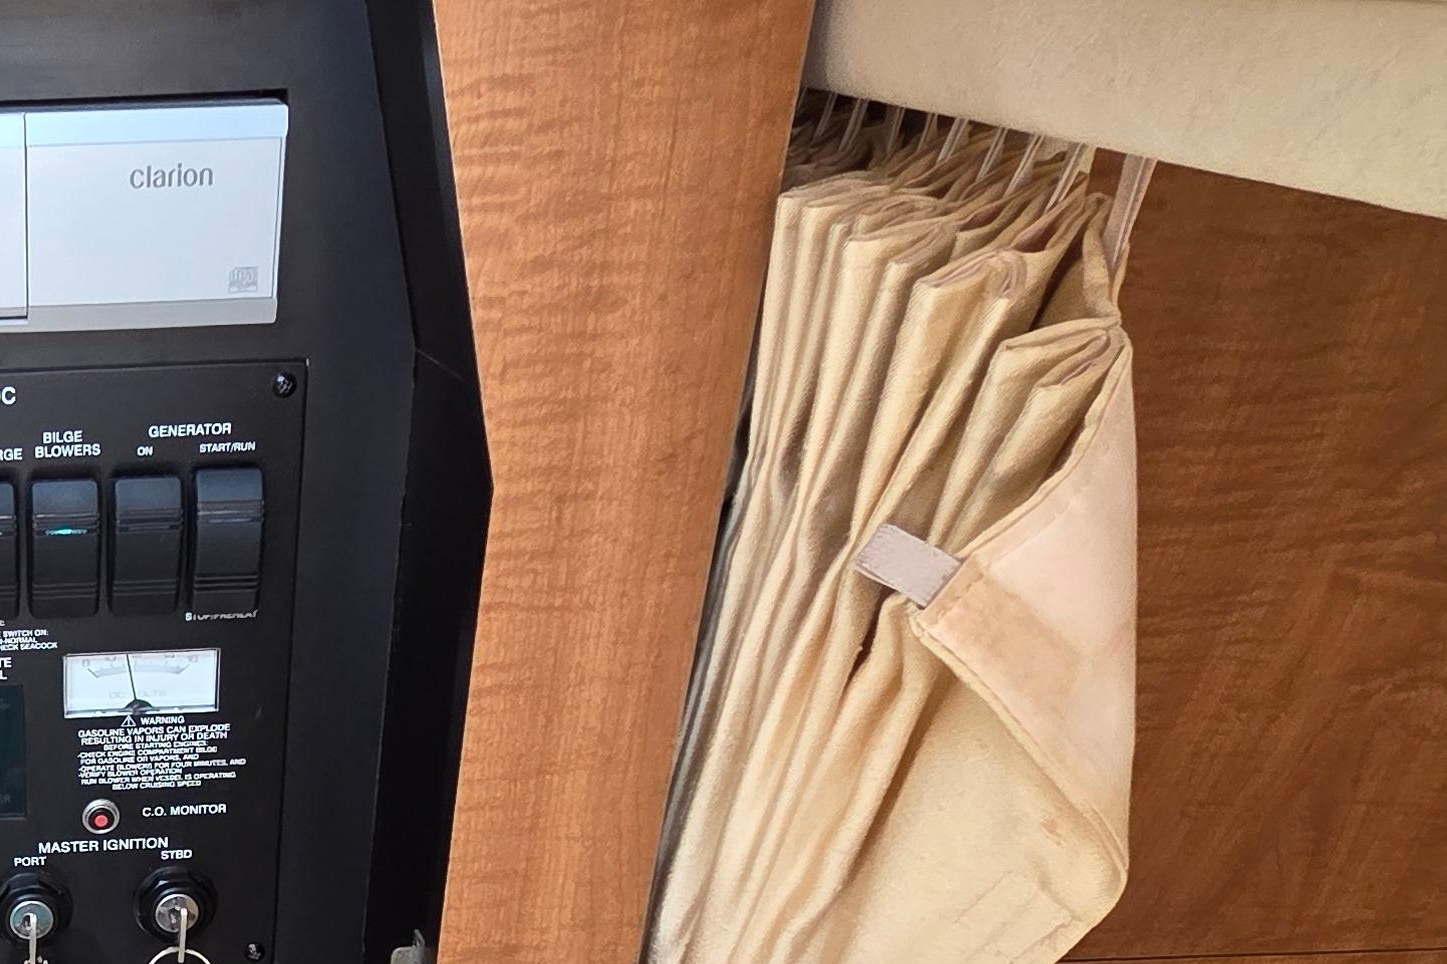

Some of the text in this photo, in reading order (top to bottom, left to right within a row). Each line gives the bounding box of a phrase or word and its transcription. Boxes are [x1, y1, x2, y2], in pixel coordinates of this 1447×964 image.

[130, 163, 213, 189] clarion
[149, 423, 231, 437] GENERATOR
[43, 431, 82, 444] BILGE
[35, 444, 101, 458] BLOWERS
[137, 446, 153, 456] ON
[200, 442, 255, 453] START/RUN
[141, 716, 185, 724] WARNING
[78, 724, 230, 738] GASOLINE VAPORS CAN EXPLODE
[81, 735, 132, 745] RESULTING
[146, 734, 178, 742] INJURY
[181, 733, 194, 741] OR
[197, 732, 227, 740] DEATH
[142, 804, 227, 817] C.O. MONITOR
[39, 837, 168, 854] MASTER IGNITION
[14, 856, 46, 866] PORT
[161, 850, 192, 860] STBD
